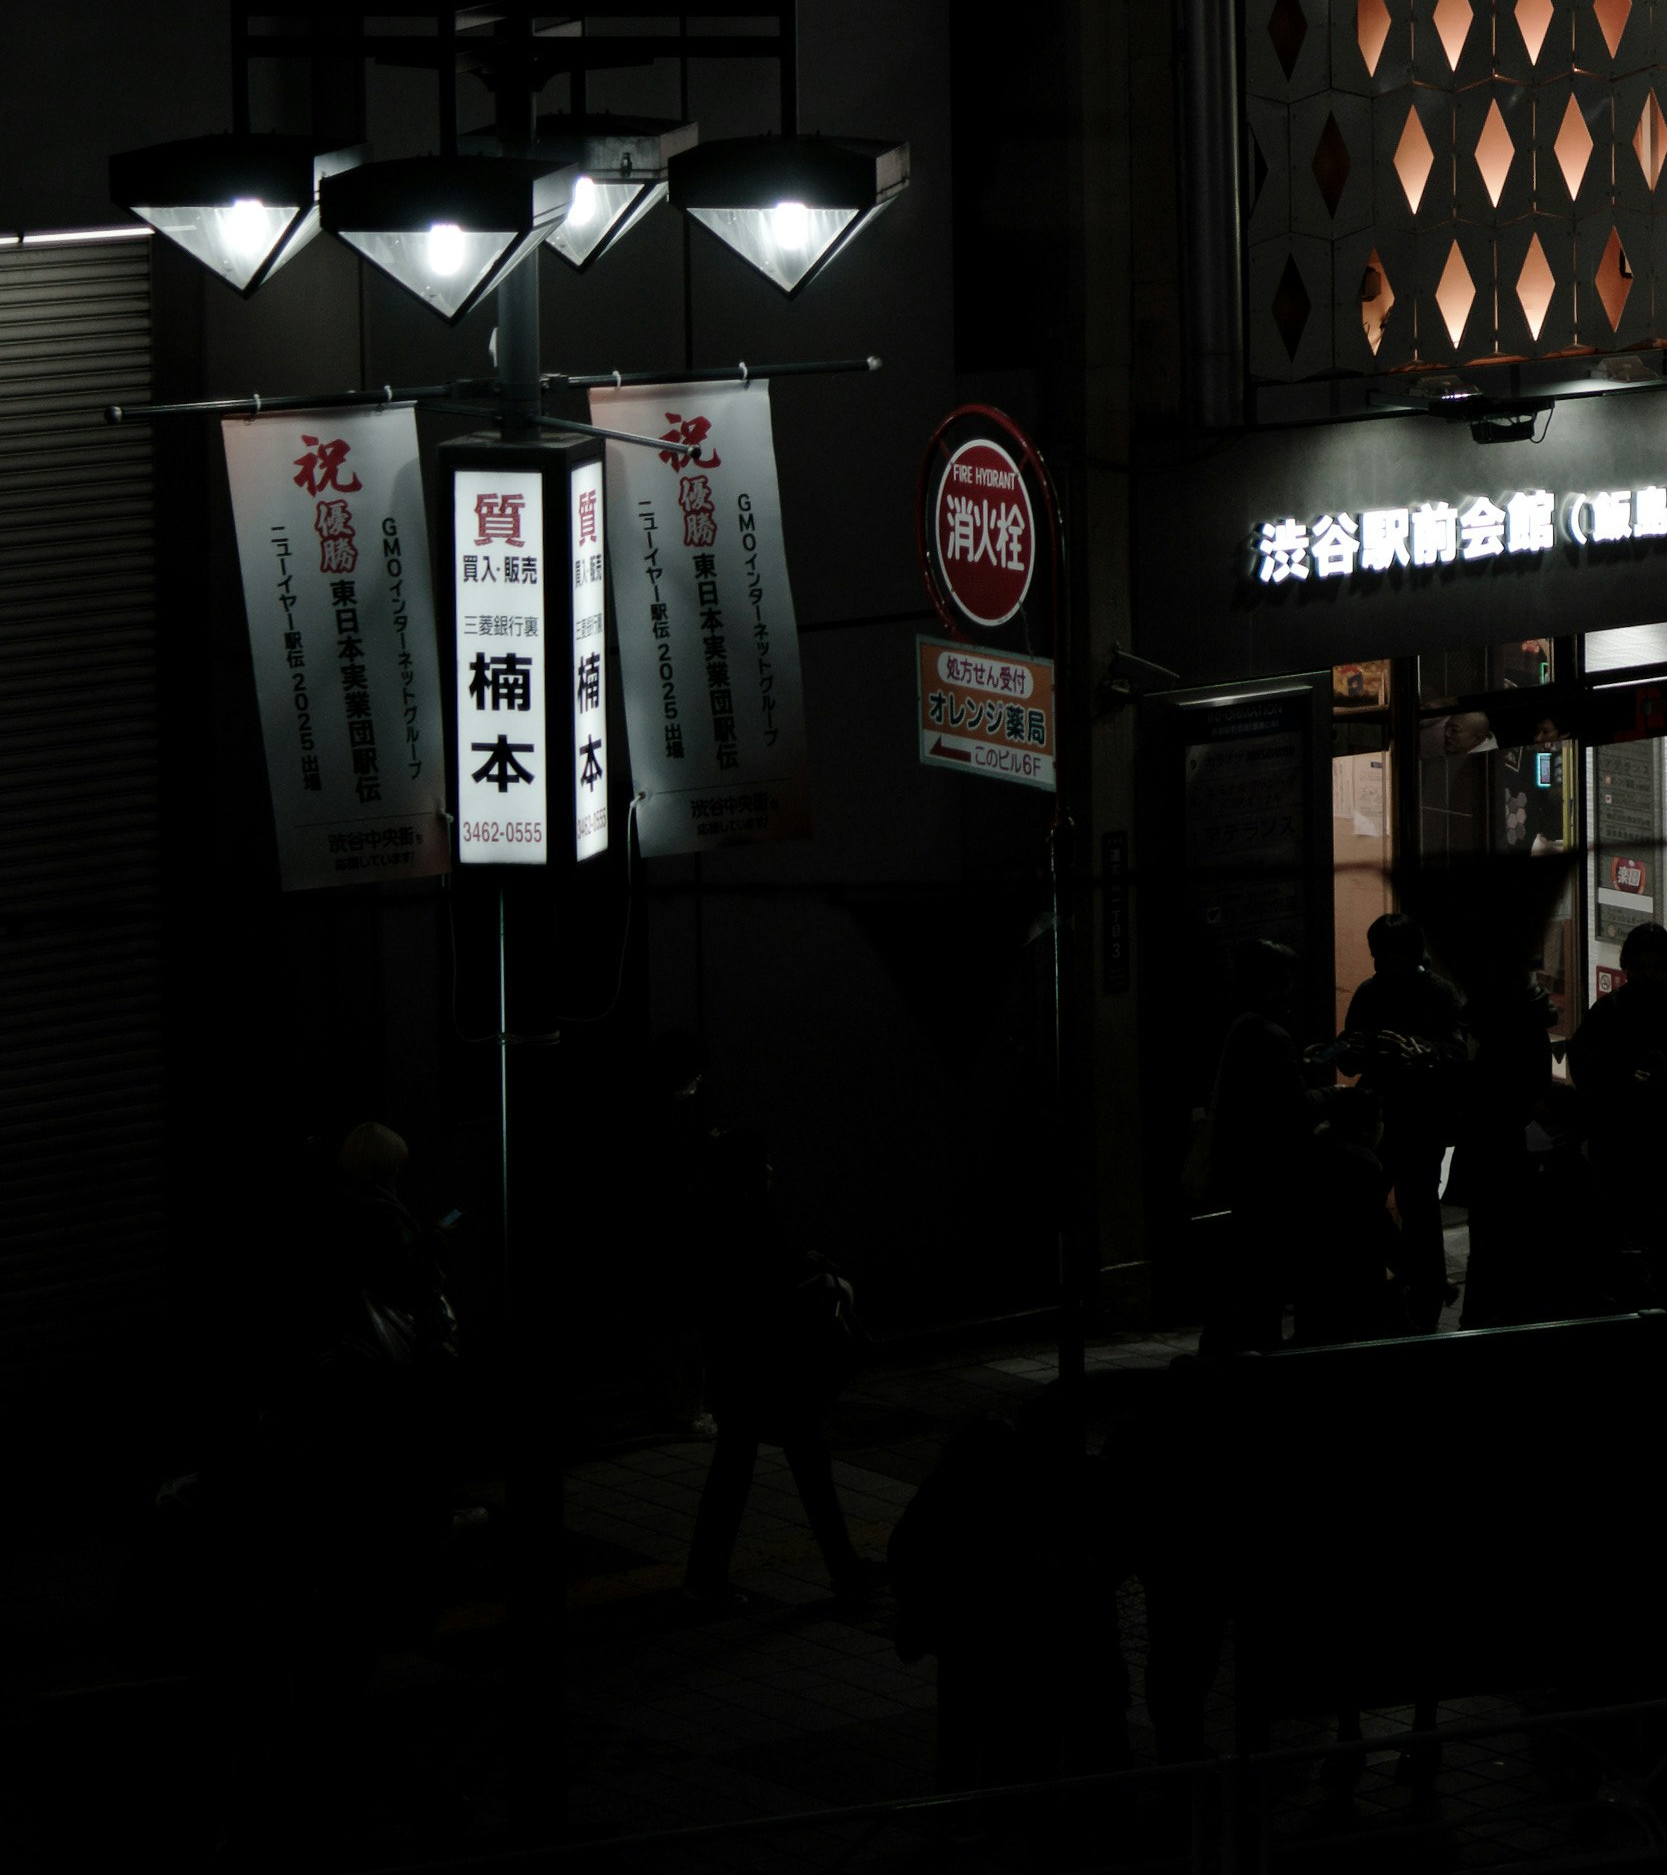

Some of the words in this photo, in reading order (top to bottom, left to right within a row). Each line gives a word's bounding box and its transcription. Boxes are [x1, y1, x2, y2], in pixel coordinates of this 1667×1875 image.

[293, 435, 362, 497] 祝
[658, 412, 721, 473] 祝
[953, 463, 973, 485] FIRE
[975, 467, 1017, 492] HYDRANT
[314, 498, 359, 574] 優勝
[474, 492, 526, 548] 質
[579, 489, 597, 548] 質
[679, 474, 718, 548] 優勝
[946, 494, 1026, 572] 消火栓
[463, 615, 539, 638] 三菱銀行裏
[329, 580, 382, 803] 東日本実業団駅伝
[692, 553, 738, 771] 東日本実業団駅伝
[946, 656, 1026, 695] 処方せん受付
[469, 651, 536, 793] 楠本
[577, 651, 604, 793] 楠本
[930, 691, 1046, 746] オレンジ薬局
[463, 821, 542, 843] 3462-0555
